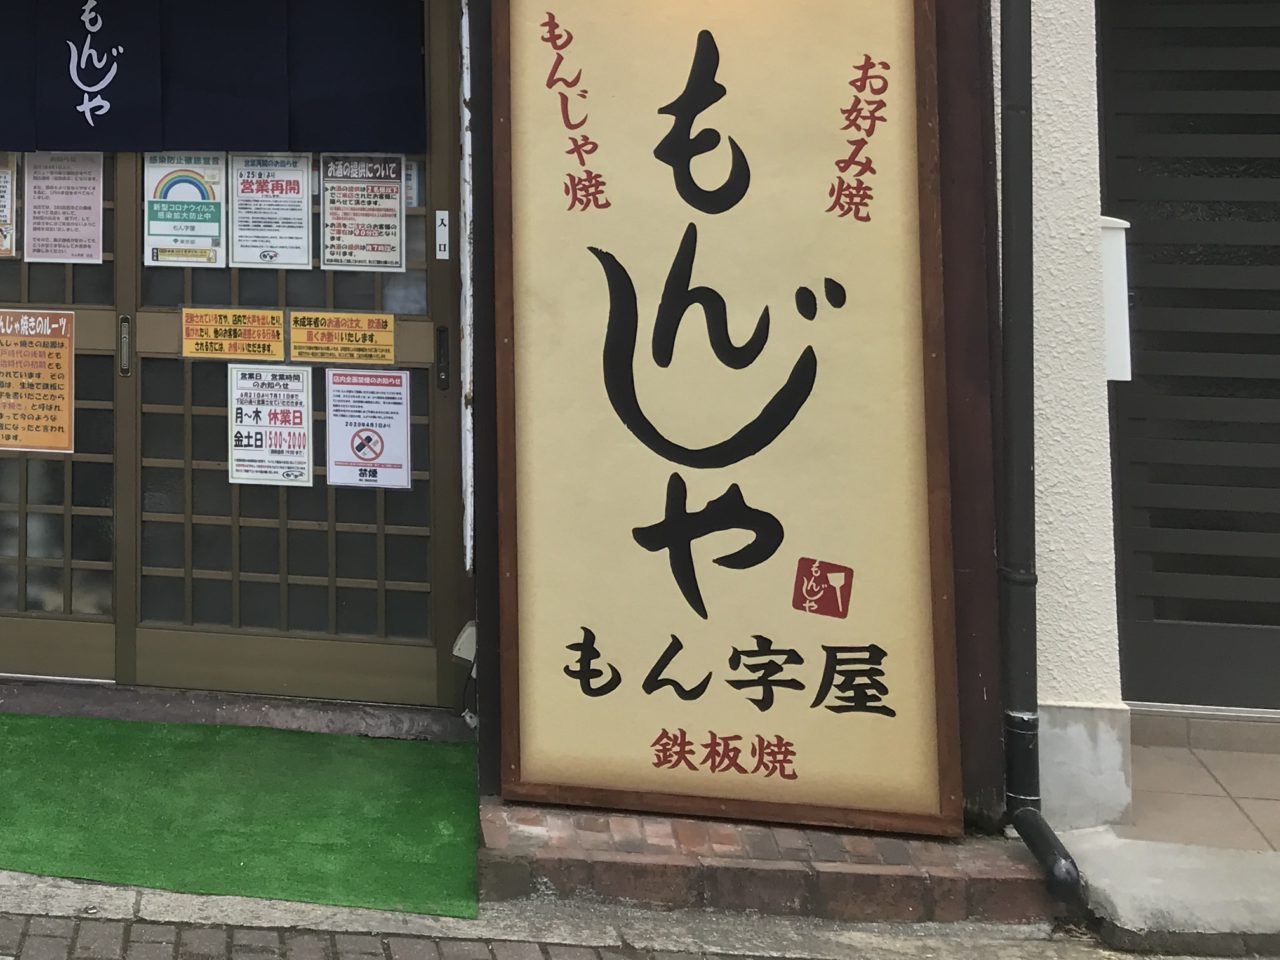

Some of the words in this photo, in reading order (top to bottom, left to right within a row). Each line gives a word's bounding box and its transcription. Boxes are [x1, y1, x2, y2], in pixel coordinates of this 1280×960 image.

[539, 12, 612, 213] もんじゃ焼
[824, 53, 891, 223] お好み焼
[327, 160, 397, 179] お酒の提供について
[240, 179, 300, 194] 営業再開
[153, 203, 216, 212] 新型コロナウイルス
[157, 212, 212, 220] 感染拡大防止中
[438, 218, 447, 252] 入口
[253, 381, 289, 389] のお知らせ
[268, 409, 303, 426] 休業日
[233, 430, 263, 449] 金土日
[359, 468, 378, 478] 禁煙
[563, 626, 896, 718] もん字屋
[650, 728, 798, 780] 鉄板焼
